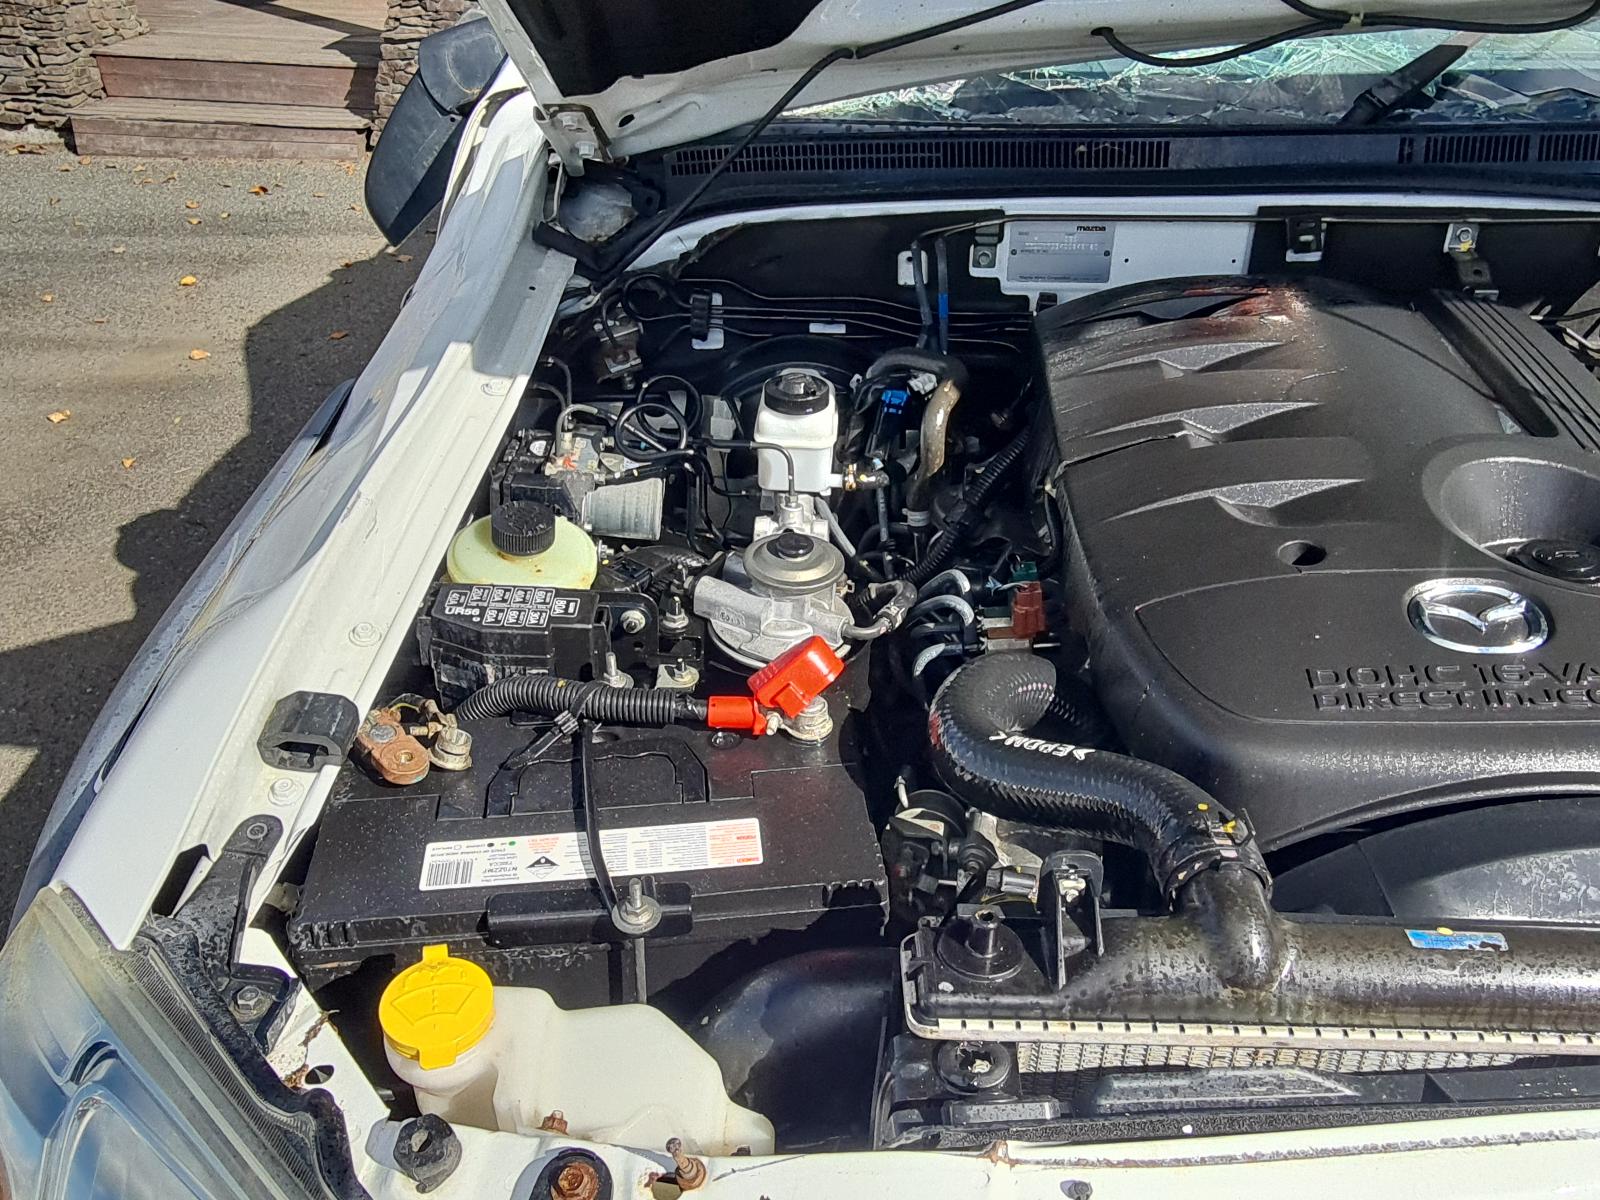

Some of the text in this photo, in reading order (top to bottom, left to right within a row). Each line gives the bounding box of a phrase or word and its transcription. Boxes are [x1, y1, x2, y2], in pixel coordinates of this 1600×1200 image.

[444, 606, 480, 616] UR56
[1305, 664, 1467, 690] DOHC
[1312, 689, 1475, 713] DIRECT
